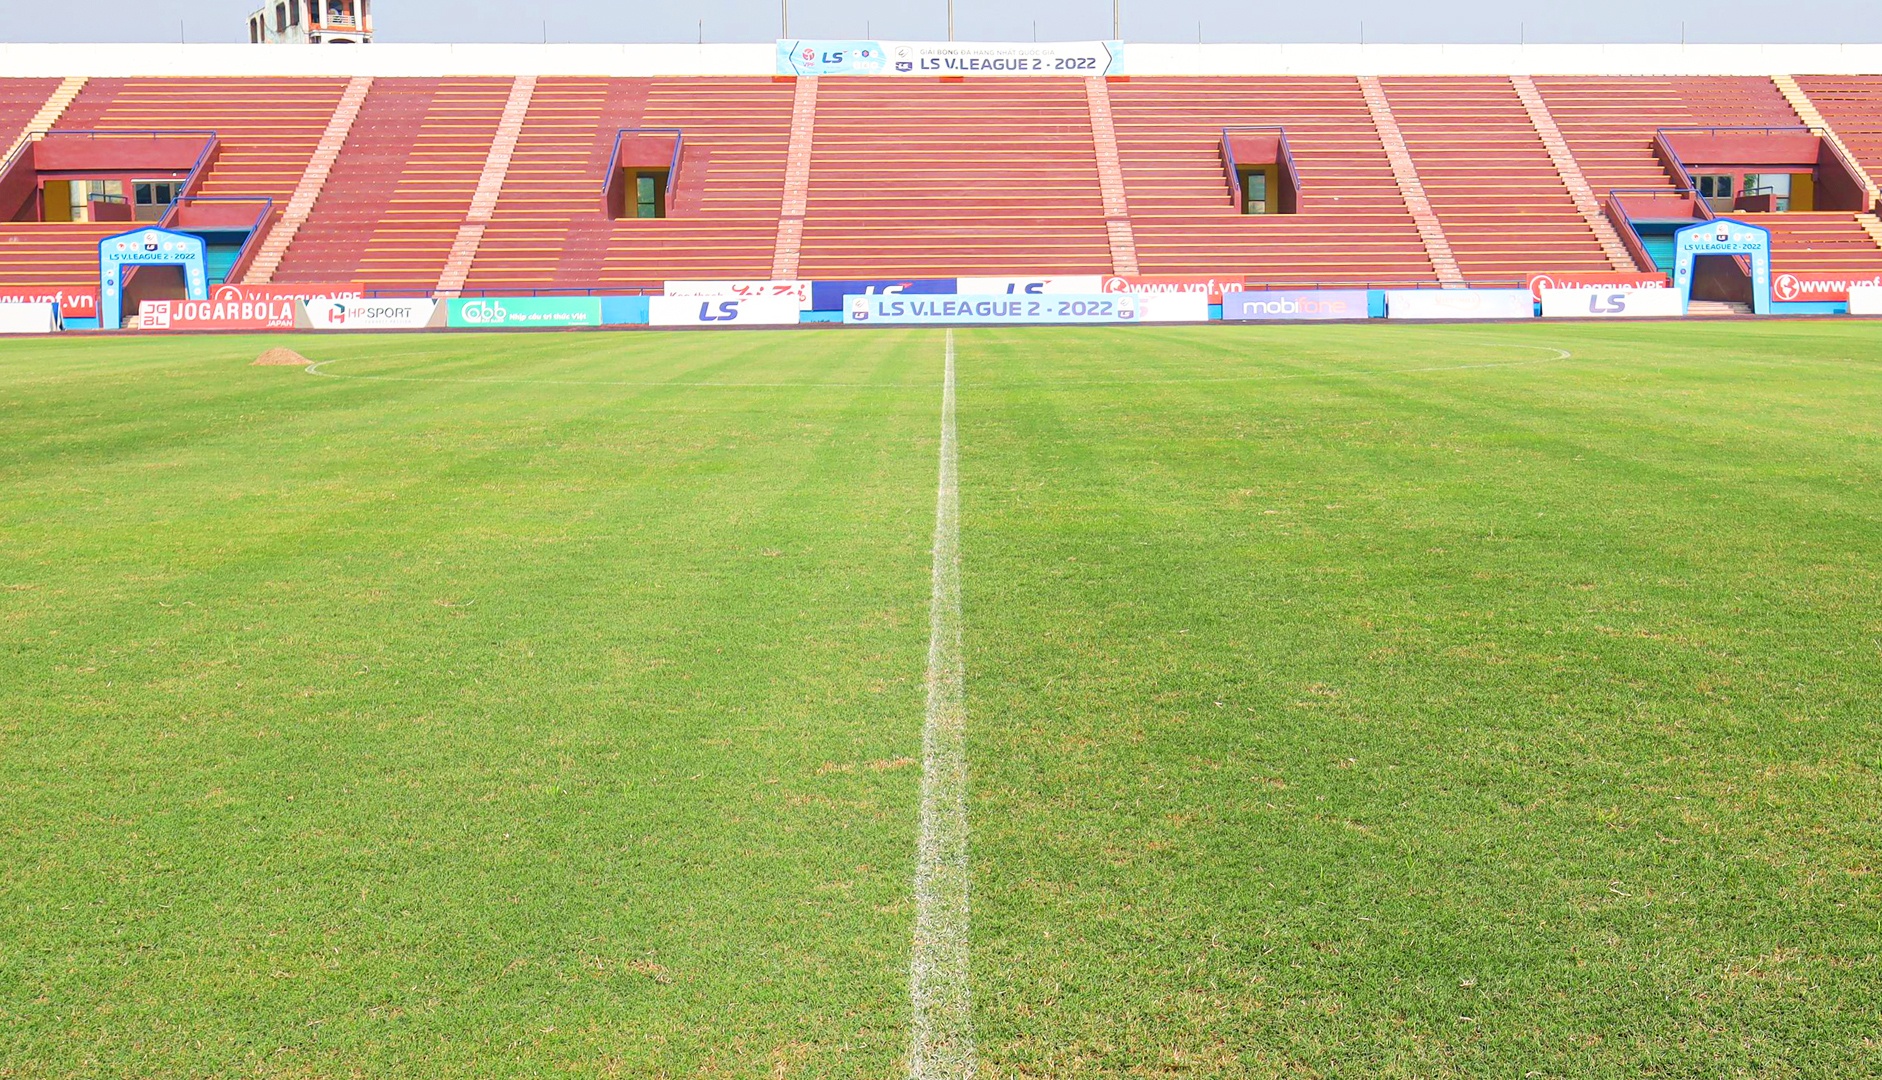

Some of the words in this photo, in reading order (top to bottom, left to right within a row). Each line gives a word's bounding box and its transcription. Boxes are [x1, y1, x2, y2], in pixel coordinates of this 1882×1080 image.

[822, 52, 843, 64] LS
[920, 58, 940, 70] LS
[944, 58, 1028, 70] V.LEAGUE
[1032, 58, 1042, 70] 2
[1055, 57, 1096, 70] 2022
[1130, 279, 1243, 295] wwwvpf.vn
[144, 304, 167, 314] JG
[173, 302, 293, 320] JOGARBOLA
[698, 301, 739, 322] LS
[878, 301, 905, 316] LS
[910, 301, 1022, 317] V.LEAGUE
[1027, 301, 1040, 316] 2
[1058, 301, 1113, 316] 2022
[1243, 297, 1347, 315] mobifone
[1589, 294, 1626, 314] LS
[144, 316, 167, 326] BL
